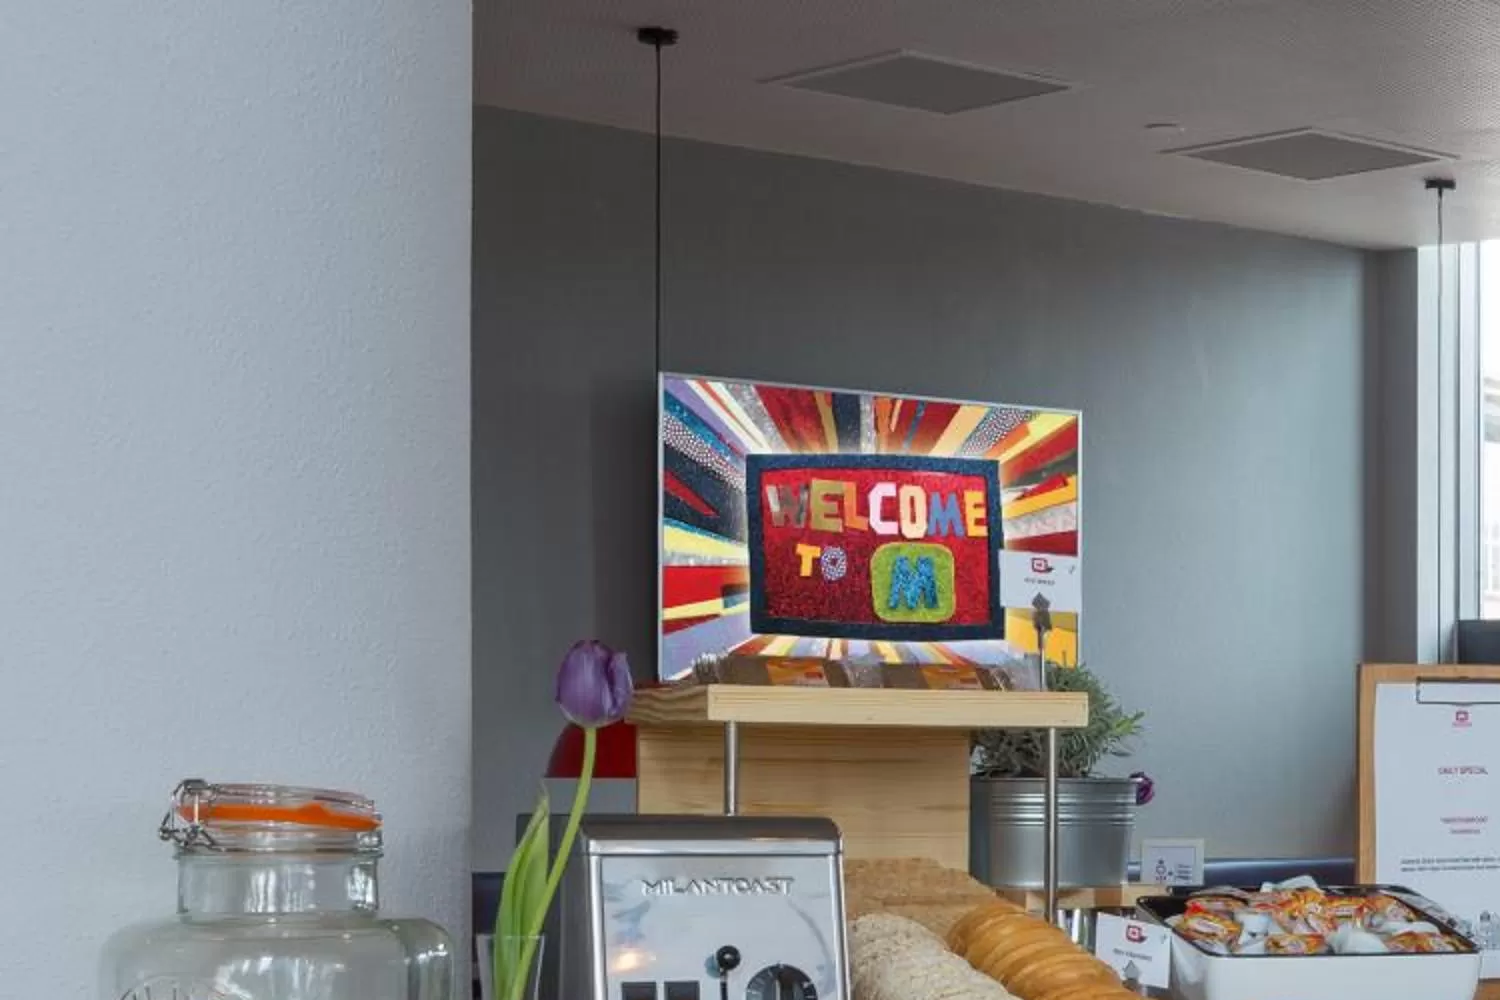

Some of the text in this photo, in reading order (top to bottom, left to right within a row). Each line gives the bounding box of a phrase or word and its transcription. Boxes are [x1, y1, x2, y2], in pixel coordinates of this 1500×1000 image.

[765, 479, 989, 539] WELCOME
[795, 544, 939, 611] TO M
[641, 877, 795, 896] MILANTOAST
